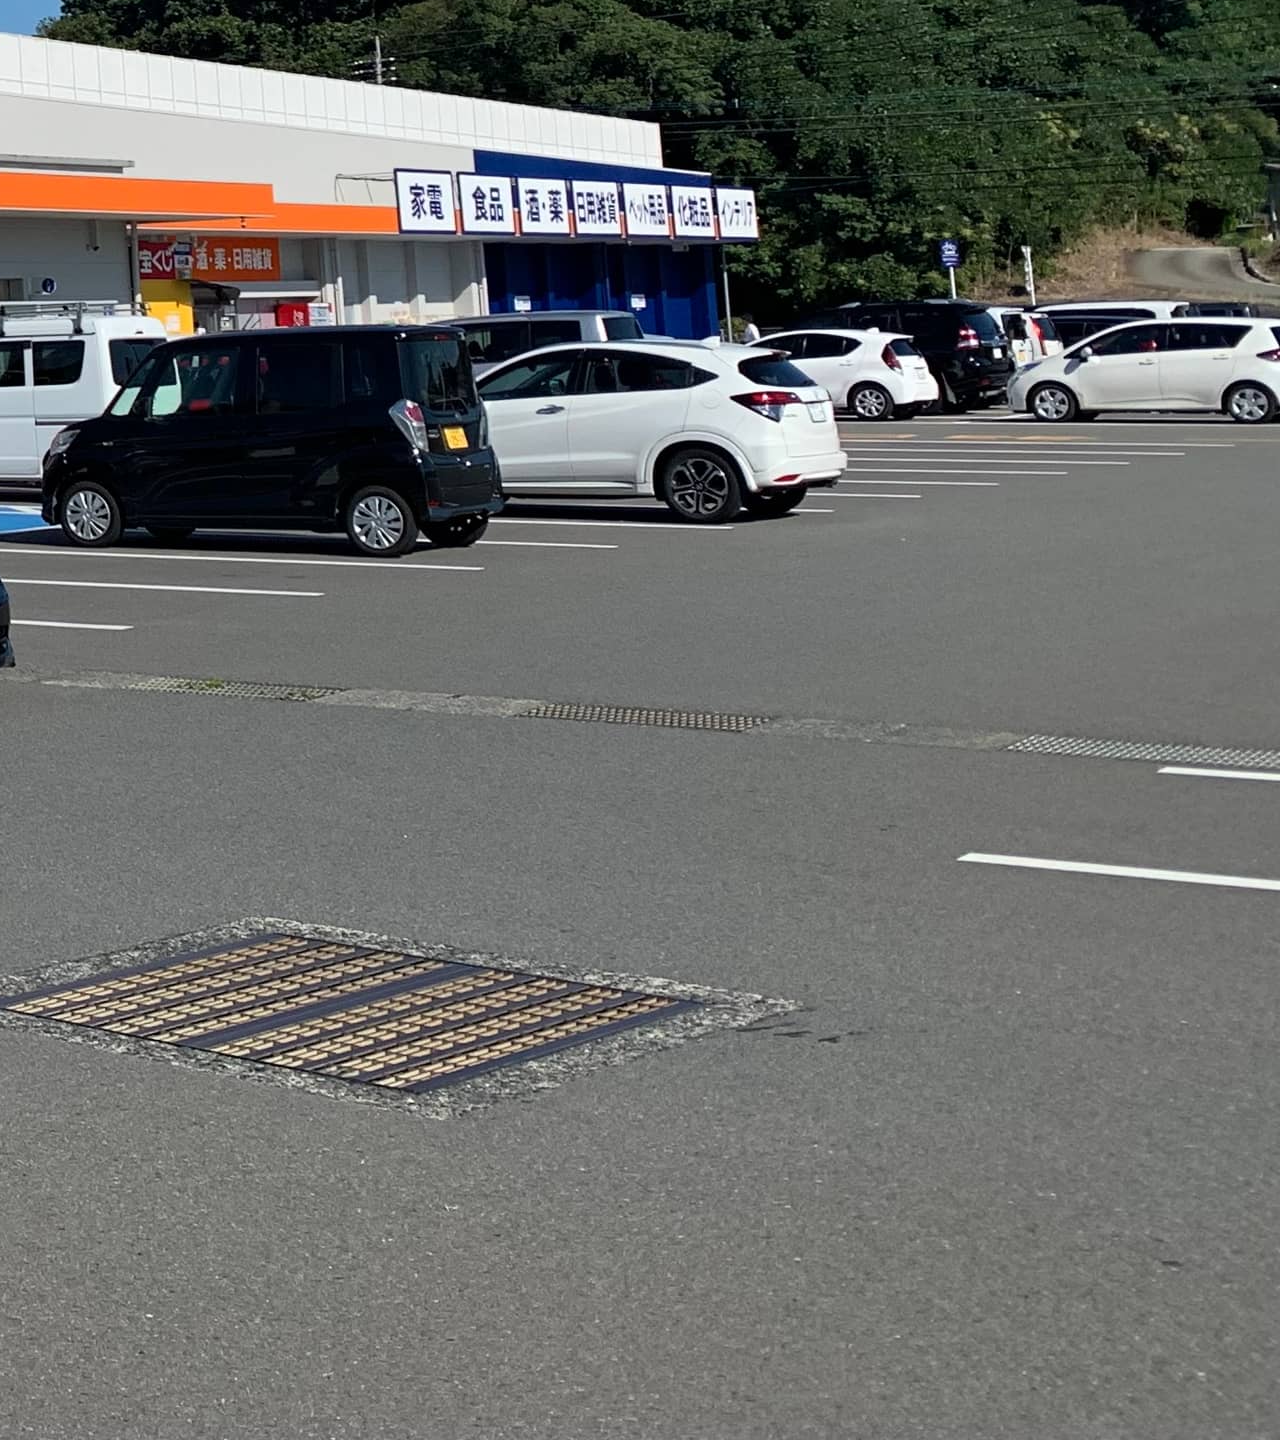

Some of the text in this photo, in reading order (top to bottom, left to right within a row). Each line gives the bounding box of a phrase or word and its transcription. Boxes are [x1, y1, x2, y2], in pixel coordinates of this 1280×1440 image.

[409, 183, 444, 220] 家電
[472, 186, 504, 222] 食品
[576, 192, 618, 224] 日用雑貨
[678, 195, 710, 227] 化粧品
[139, 249, 174, 273] 宝くじ
